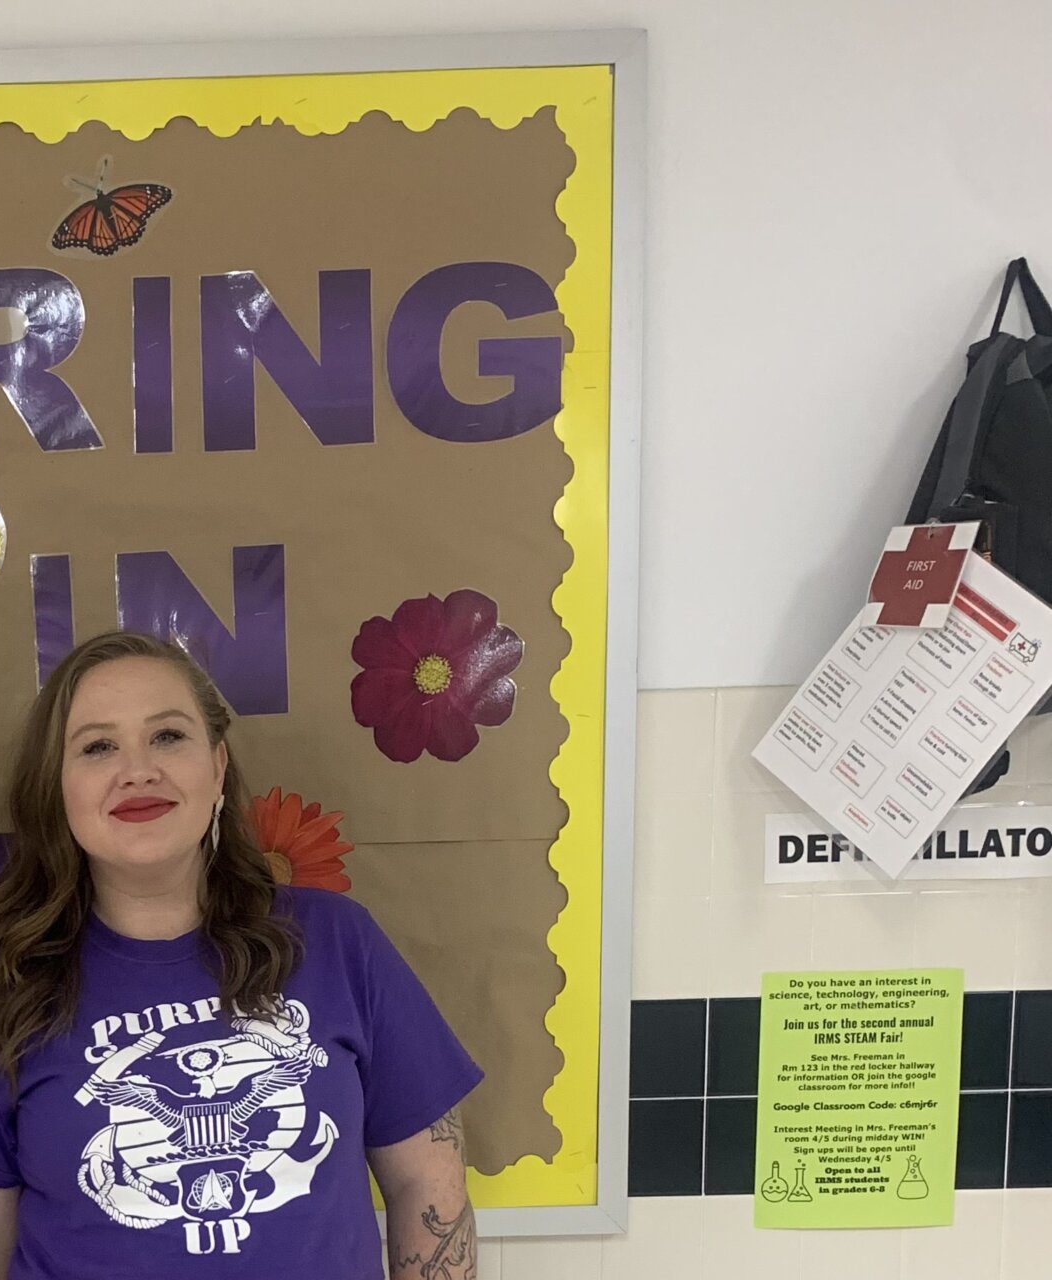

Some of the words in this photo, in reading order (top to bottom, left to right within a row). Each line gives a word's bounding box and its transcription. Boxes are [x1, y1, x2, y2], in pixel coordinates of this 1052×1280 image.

[906, 560, 936, 572] FIRST
[902, 579, 924, 590] AID
[29, 544, 289, 716] IN
[807, 981, 825, 989] you
[769, 991, 812, 1000] science,
[817, 990, 878, 999] technology,
[882, 989, 949, 998] engineering,
[841, 1000, 915, 1009] mathematics?
[91, 996, 250, 1047] PURP
[784, 1019, 804, 1030] Join
[808, 1020, 819, 1029] us
[823, 1019, 837, 1028] for
[841, 1018, 857, 1028] the
[861, 1017, 896, 1028] second
[900, 1016, 934, 1027] annual
[814, 1033, 840, 1044] IRMS
[844, 1032, 877, 1043] STEAM
[880, 1032, 903, 1042] Fair!
[868, 1073, 884, 1081] join
[773, 1103, 809, 1112] Google
[814, 1102, 865, 1110] Classroom
[900, 1101, 937, 1109] c6mjr6r
[816, 1126, 852, 1134] Meeting
[833, 1135, 862, 1143] during
[866, 1134, 898, 1143] midday
[818, 1155, 871, 1164] Wednesday
[825, 1167, 851, 1176] Open
[832, 1186, 867, 1195] grades
[182, 1218, 250, 1254] UP
